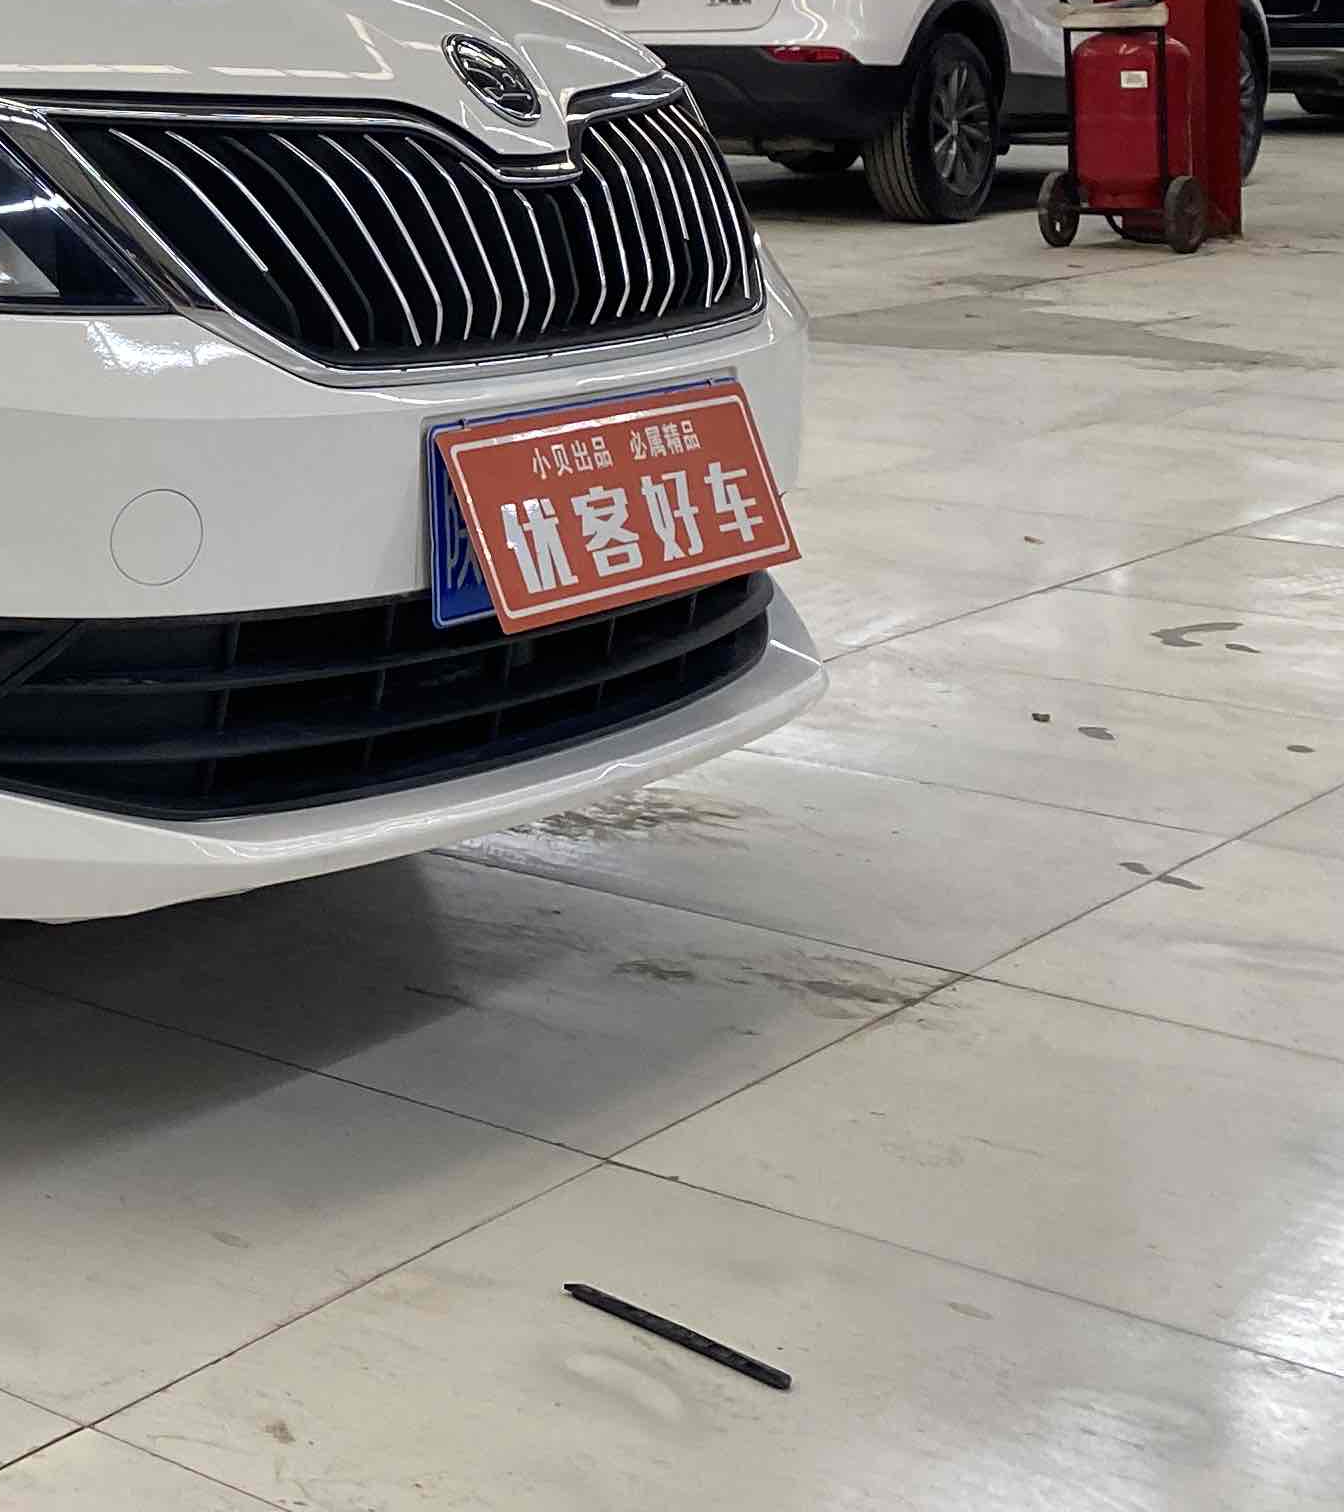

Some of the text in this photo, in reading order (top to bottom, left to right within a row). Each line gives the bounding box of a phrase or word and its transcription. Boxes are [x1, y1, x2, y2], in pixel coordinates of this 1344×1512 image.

[532, 419, 701, 480] 小贝出品 必属精品
[500, 461, 765, 594] 优客好车
